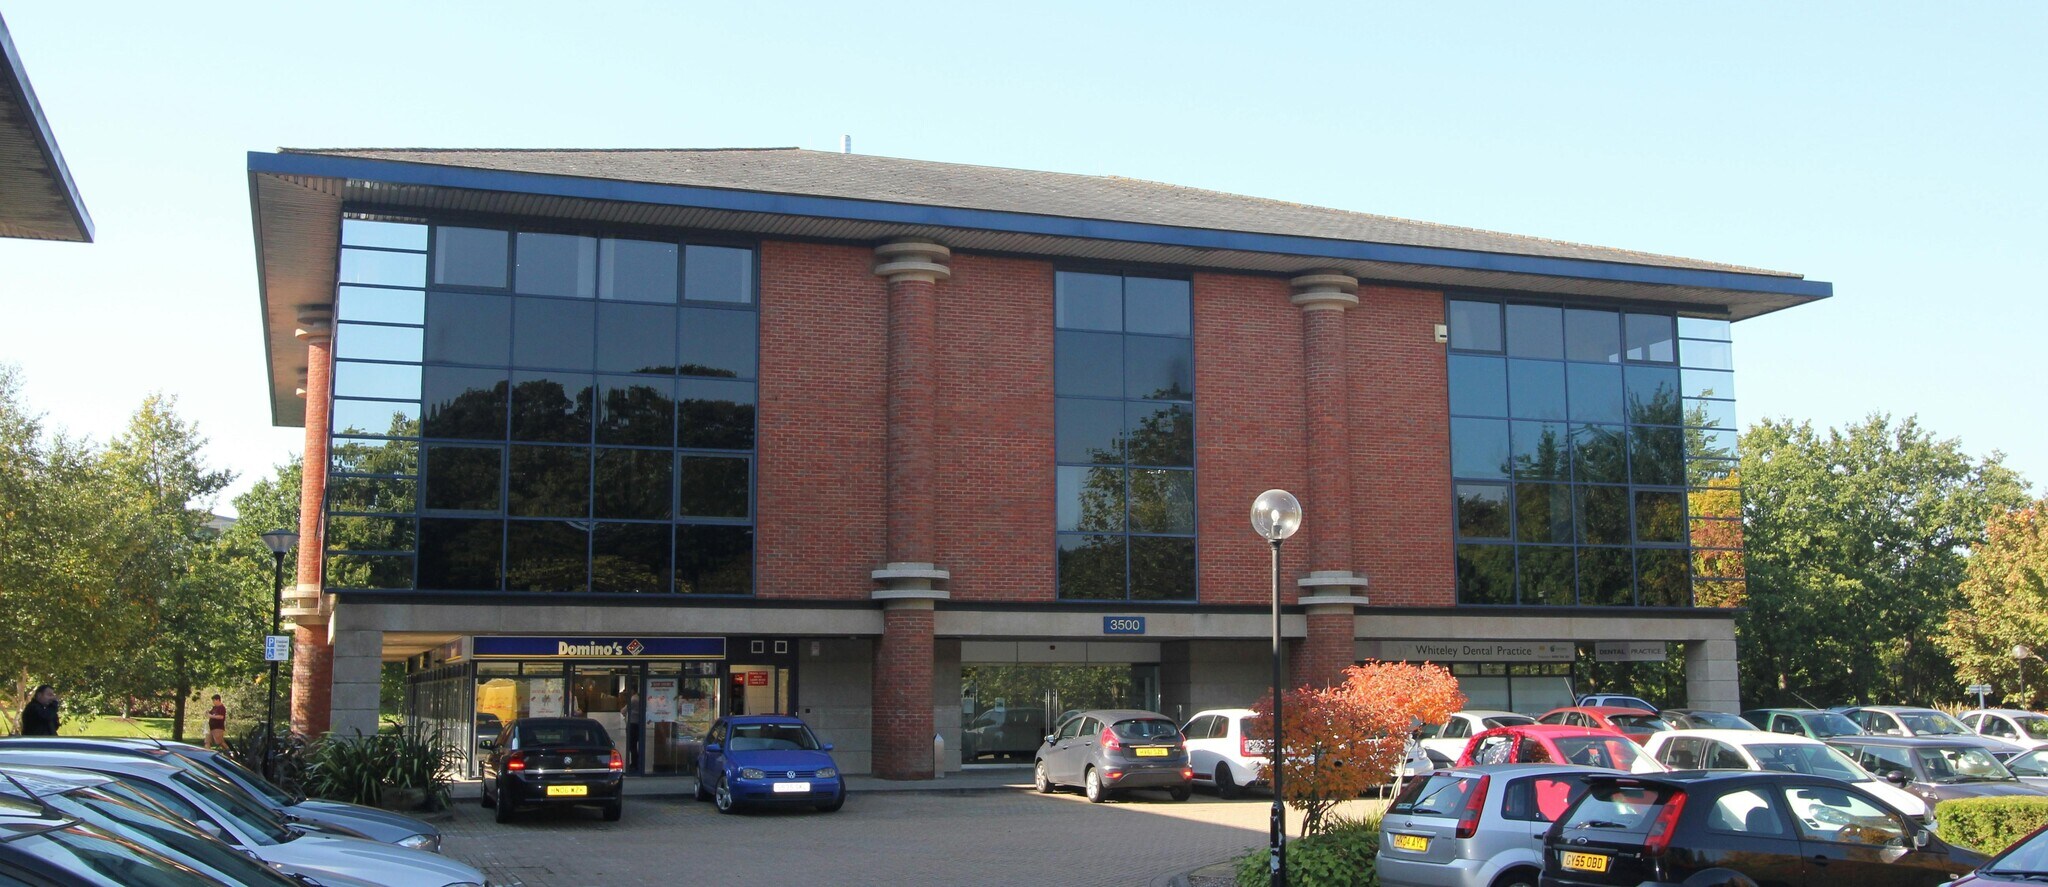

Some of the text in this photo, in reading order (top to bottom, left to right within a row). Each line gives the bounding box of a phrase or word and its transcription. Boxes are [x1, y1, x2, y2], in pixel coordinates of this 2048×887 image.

[1110, 619, 1140, 631] 3500
[558, 641, 623, 656] Domino's
[1415, 645, 1532, 658] Whiteley Dental Practice
[1566, 854, 1603, 869] GY55 OBD
